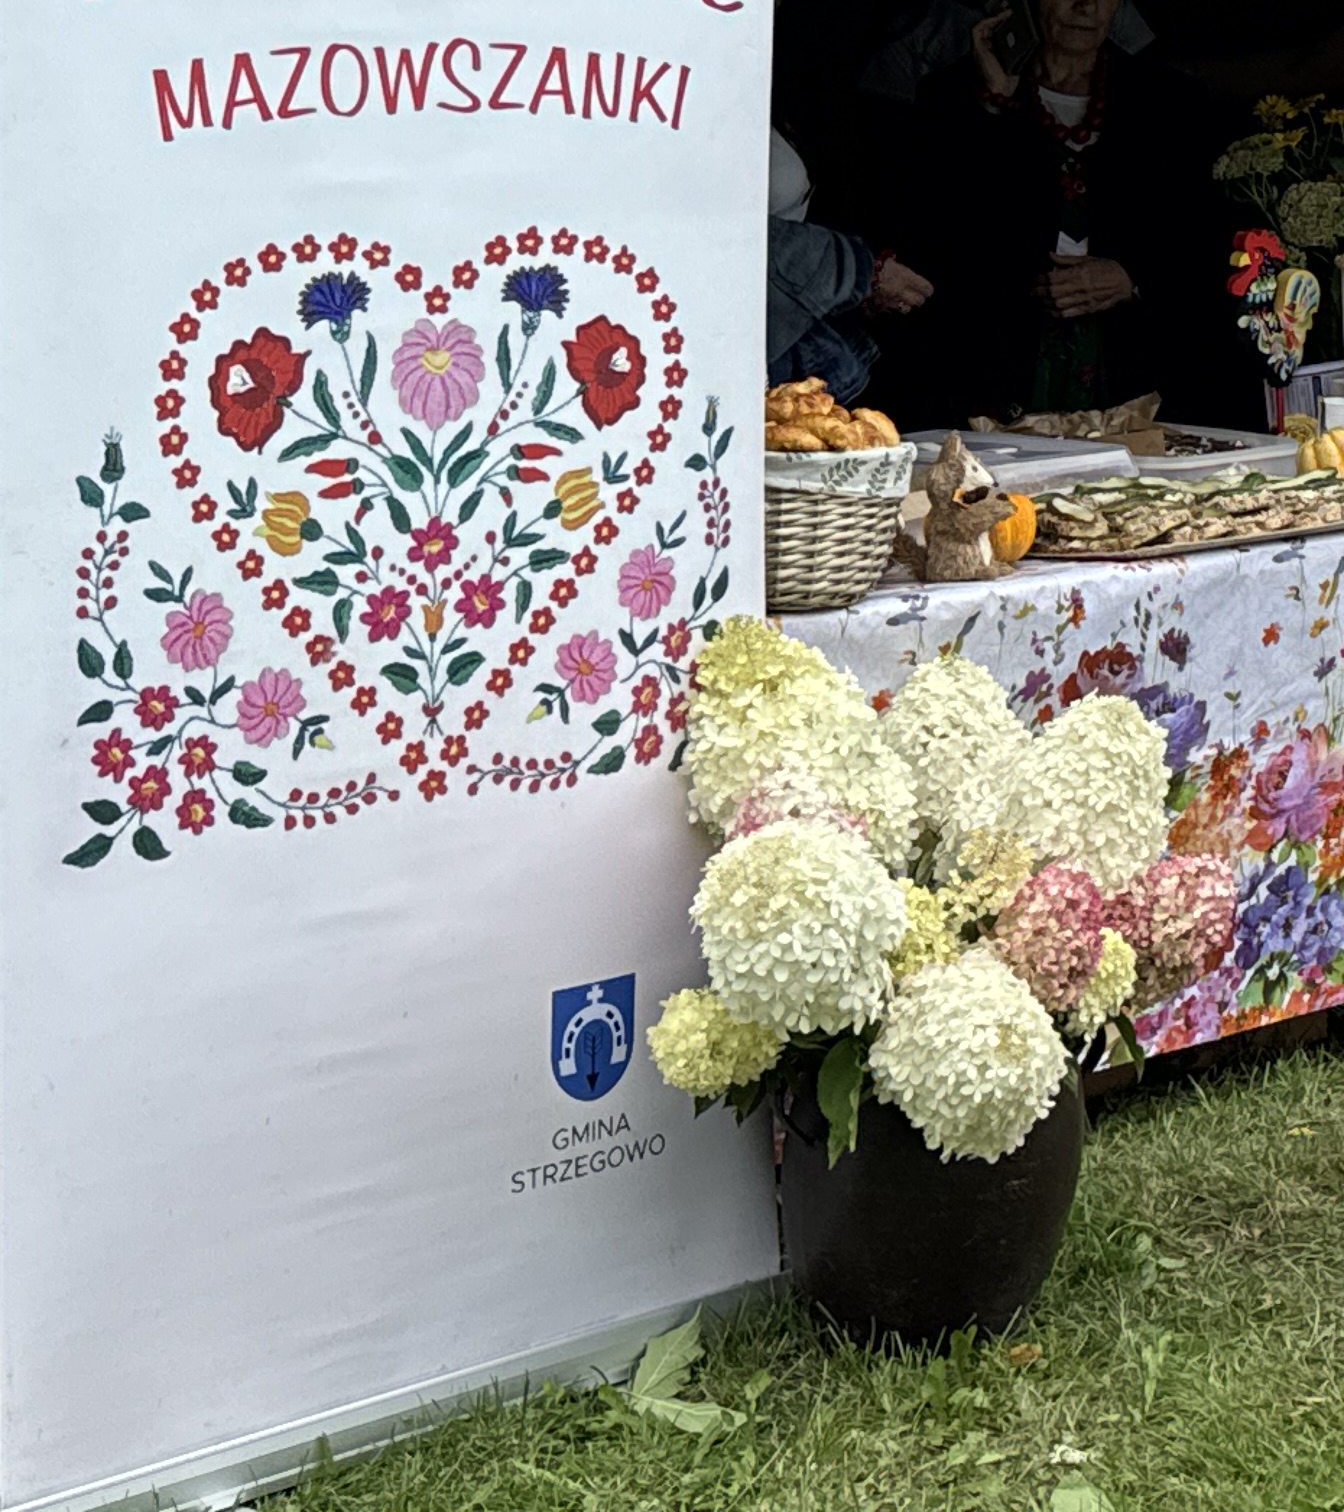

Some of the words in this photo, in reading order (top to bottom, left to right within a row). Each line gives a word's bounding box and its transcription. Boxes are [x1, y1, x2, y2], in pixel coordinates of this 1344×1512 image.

[151, 37, 690, 142] MAZOWSZANKI
[551, 1112, 631, 1151] GMINA
[510, 1133, 666, 1194] STRZEGOWO
